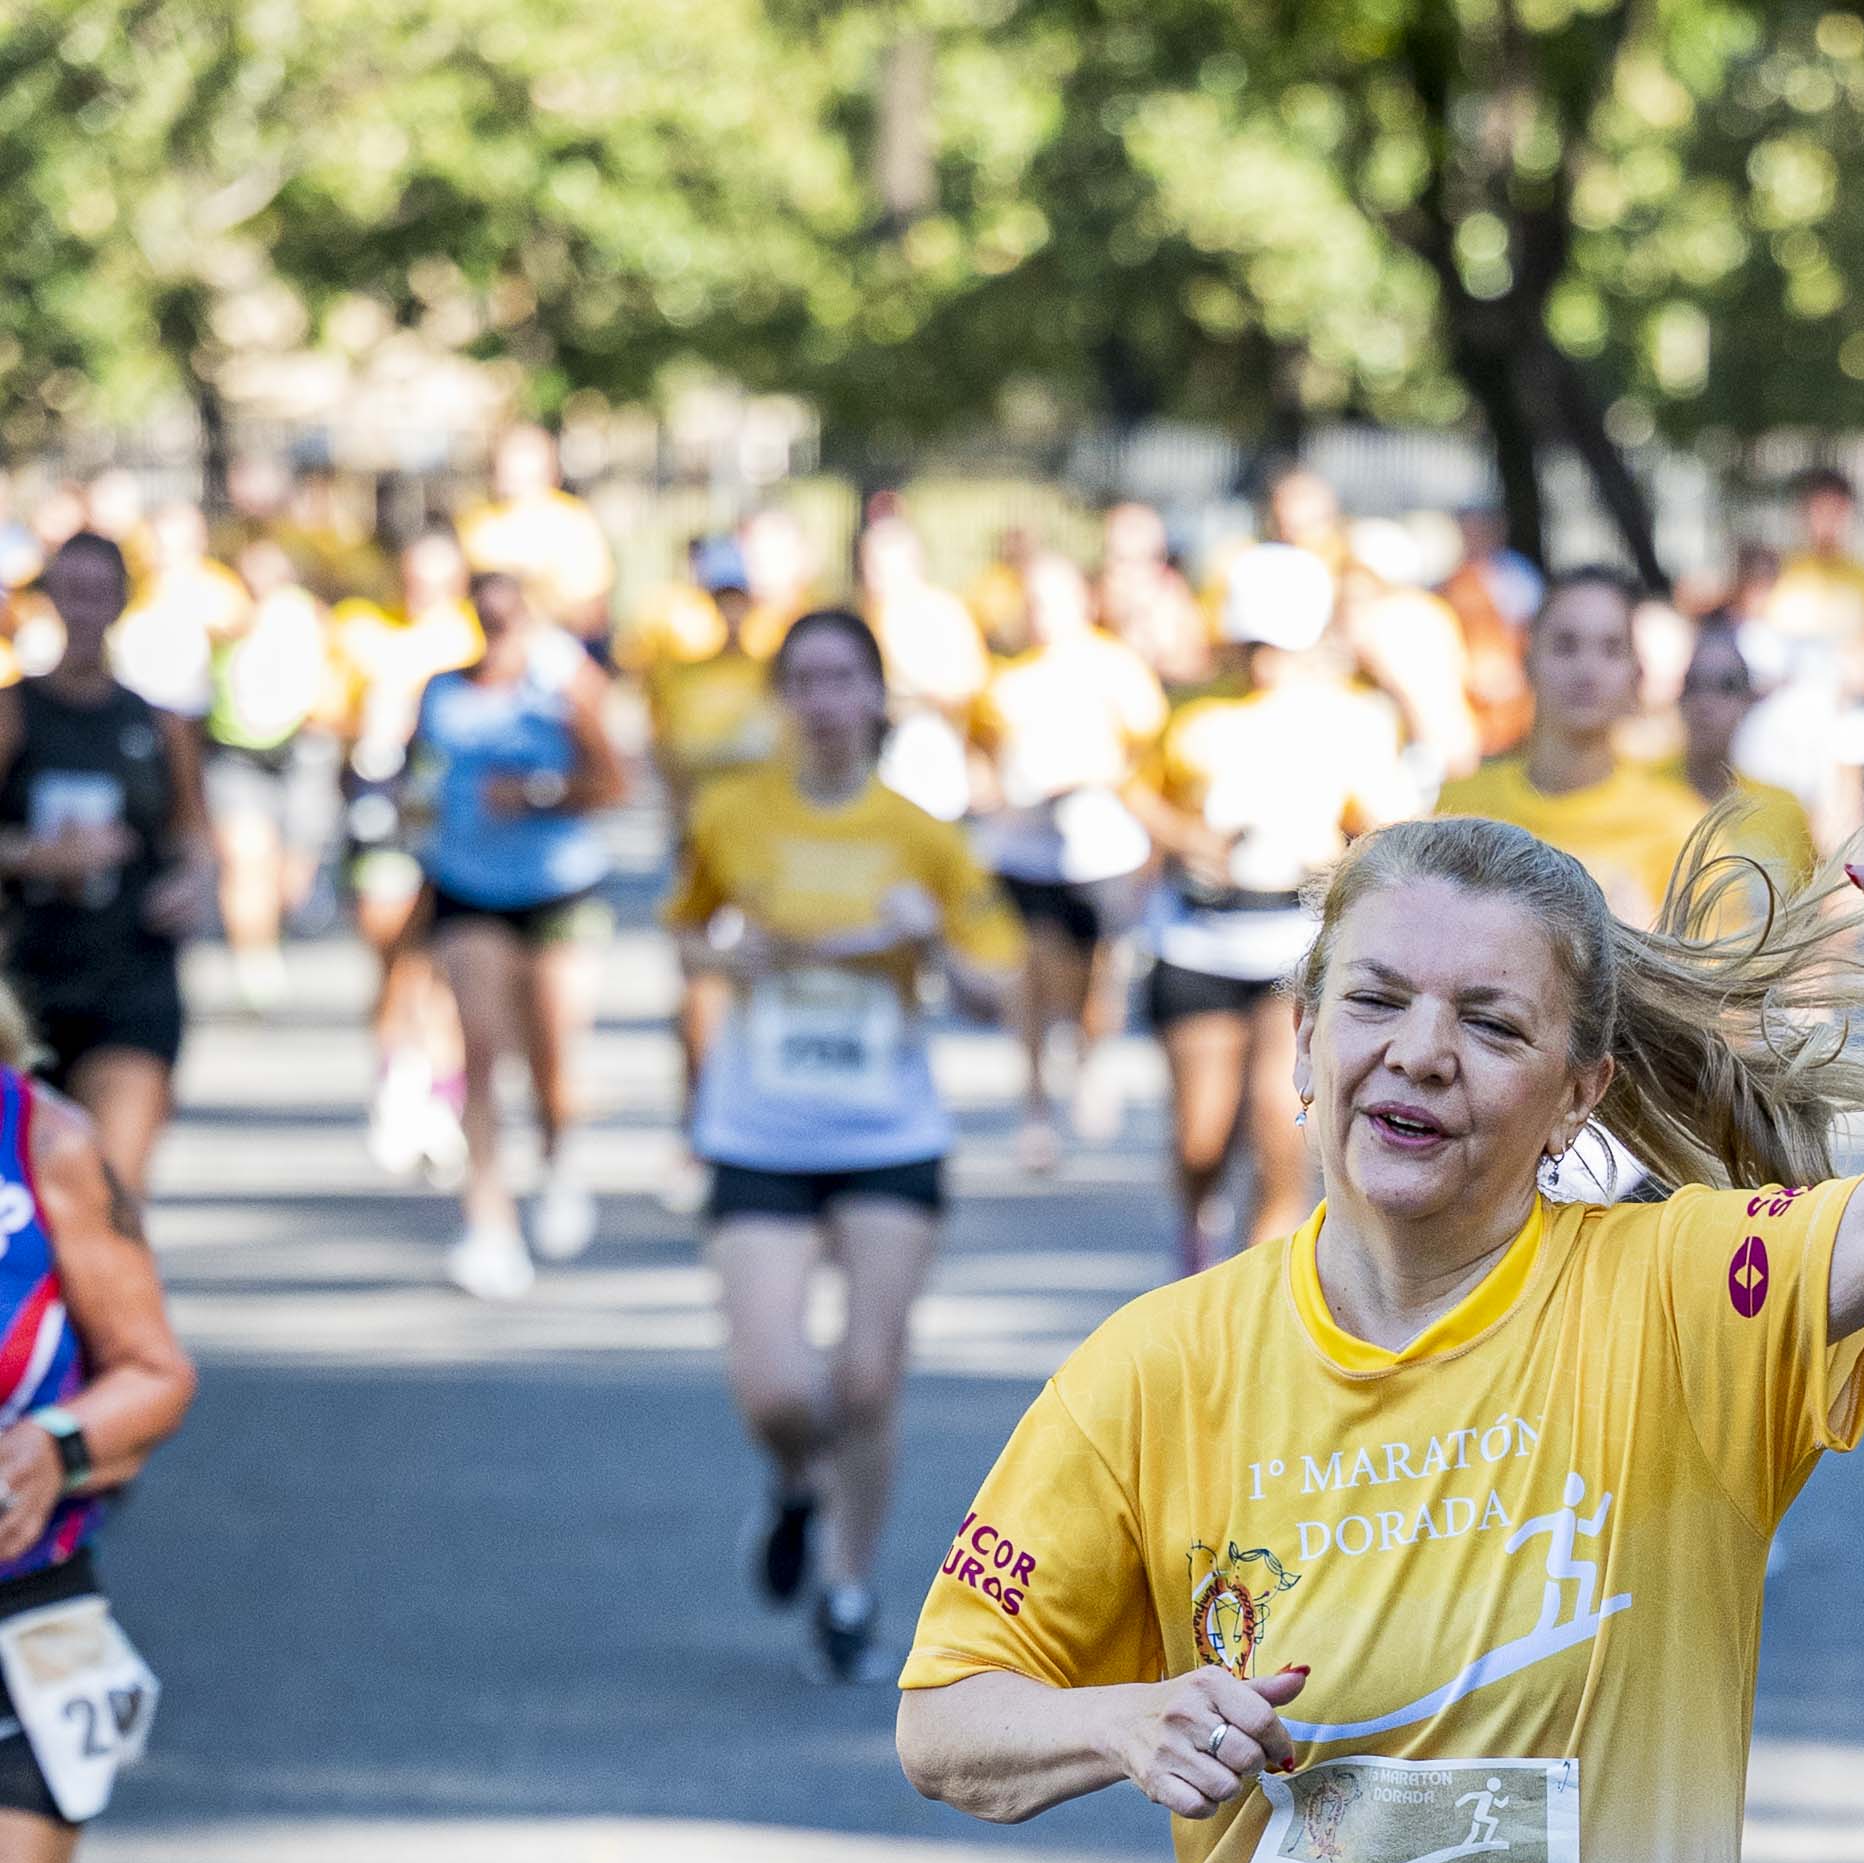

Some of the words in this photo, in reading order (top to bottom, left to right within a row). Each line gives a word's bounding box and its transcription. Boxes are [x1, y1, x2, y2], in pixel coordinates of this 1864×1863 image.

[1300, 1412, 1545, 1494] MARATÓN
[1296, 1488, 1512, 1561] DORADA
[1373, 1786, 1435, 1804] DORADA
